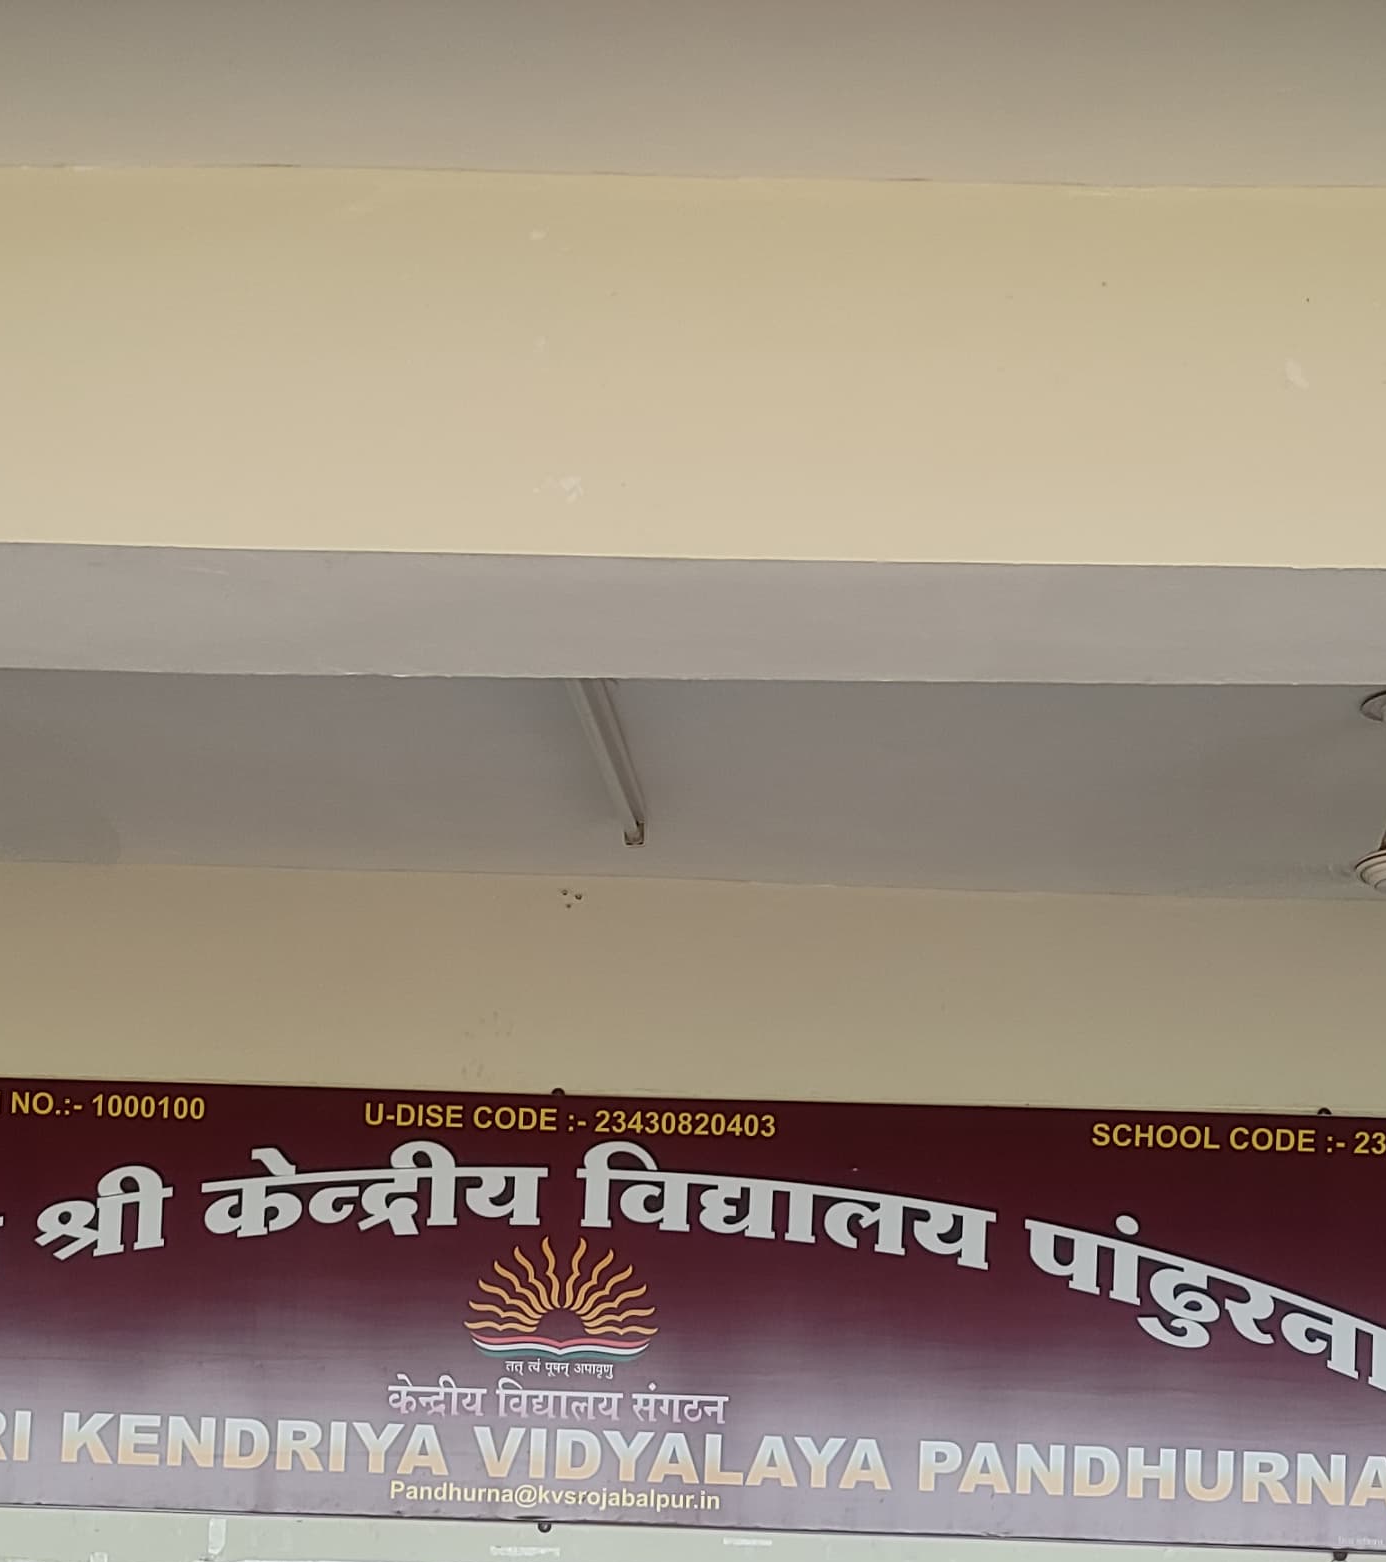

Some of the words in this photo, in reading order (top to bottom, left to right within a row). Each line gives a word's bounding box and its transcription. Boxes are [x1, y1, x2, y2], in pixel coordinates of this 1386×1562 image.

[91, 1093, 206, 1121] 1000100
[364, 1102, 464, 1129] U-DISE
[473, 1105, 558, 1132] CODE
[594, 1110, 776, 1138] 23430820403
[1092, 1122, 1221, 1150] SCHOOL
[1231, 1126, 1315, 1154] CODE
[34, 1165, 173, 1261] श्री
[201, 1140, 549, 1237] केन्द्रीय
[576, 1140, 997, 1270] विद्यालय
[388, 1374, 487, 1417] केन्द्रीय
[496, 1378, 623, 1421] विद्यालय
[632, 1382, 729, 1425] संगठन
[60, 1412, 449, 1476] KENDRIYA
[473, 1426, 892, 1492] VIDYALAYA
[389, 1480, 720, 1512] Pandhurna@kvsrojabalpur.in
